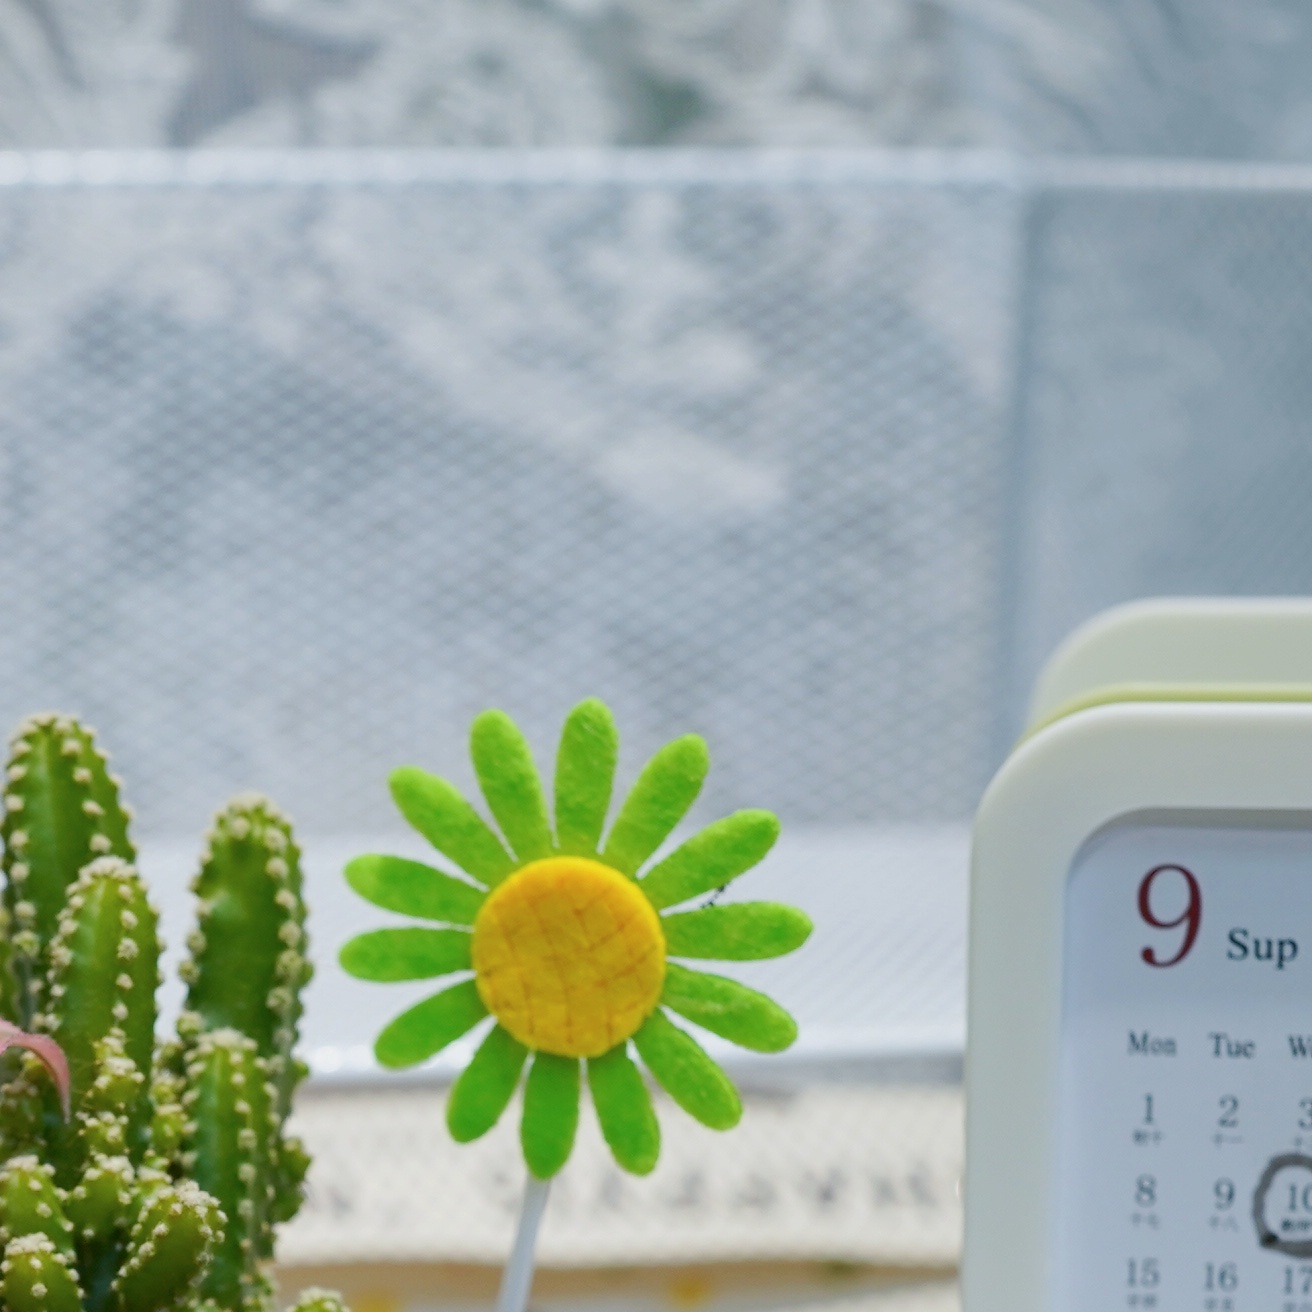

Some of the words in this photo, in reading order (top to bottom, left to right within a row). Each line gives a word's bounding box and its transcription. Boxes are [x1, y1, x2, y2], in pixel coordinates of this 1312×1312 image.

[1136, 863, 1203, 969] 9
[1226, 927, 1299, 970] Sup
[1127, 1030, 1177, 1057] Mon
[1143, 1092, 1155, 1126] 1
[1217, 1094, 1240, 1129] 2
[1297, 1097, 1312, 1130] 3
[1134, 1174, 1158, 1208] 8
[1213, 1177, 1236, 1211] 9
[1127, 1257, 1160, 1288] 15
[1204, 1262, 1239, 1292] 16
[1283, 1265, 1312, 1296] 17
